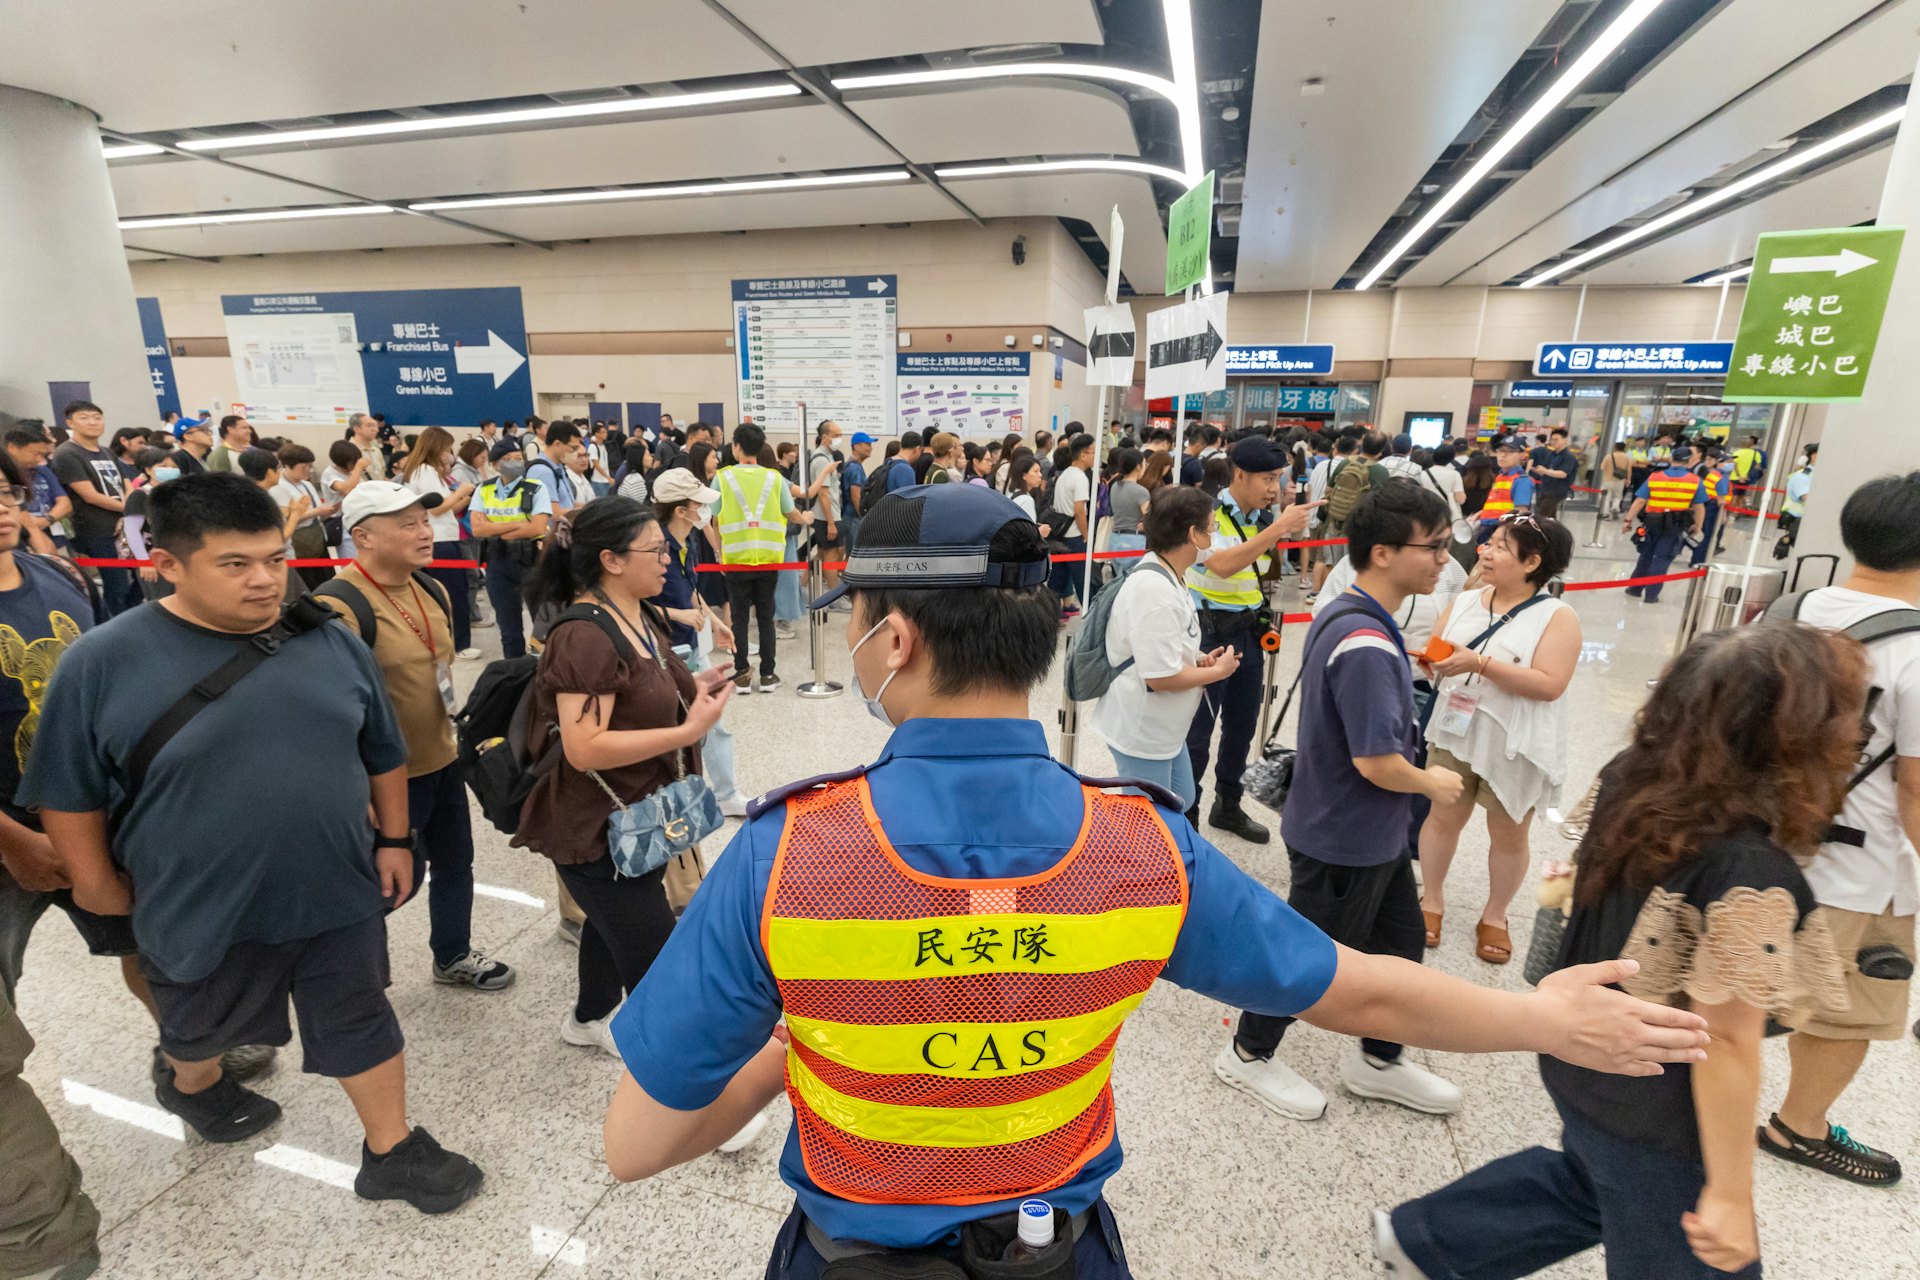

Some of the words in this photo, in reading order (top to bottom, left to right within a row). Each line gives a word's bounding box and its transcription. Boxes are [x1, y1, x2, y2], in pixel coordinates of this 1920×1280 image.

[1783, 294, 1842, 316] 嶼巴
[1774, 323, 1835, 347] 城巴
[145, 344, 166, 355] oach
[386, 341, 431, 351] Franchised
[432, 341, 449, 351] Bus
[1226, 361, 1250, 369] chised
[1250, 361, 1265, 369] Bus
[1266, 361, 1282, 369] Pick
[1283, 361, 1294, 370] Up
[1294, 361, 1313, 369] Area
[1594, 360, 1624, 369] Green
[1624, 360, 1662, 369] Minibus
[1663, 360, 1684, 369] Pick
[1684, 360, 1699, 371] Up
[1699, 360, 1723, 369] Area
[1739, 353, 1859, 377] 專線小巴
[151, 367, 165, 384] 士
[395, 384, 420, 395] Green
[421, 385, 453, 395] Minibus
[876, 560, 902, 572] 民安隊
[906, 561, 928, 572] CAS
[915, 923, 1057, 967] 民安隊
[922, 1029, 1046, 1071] CAS
